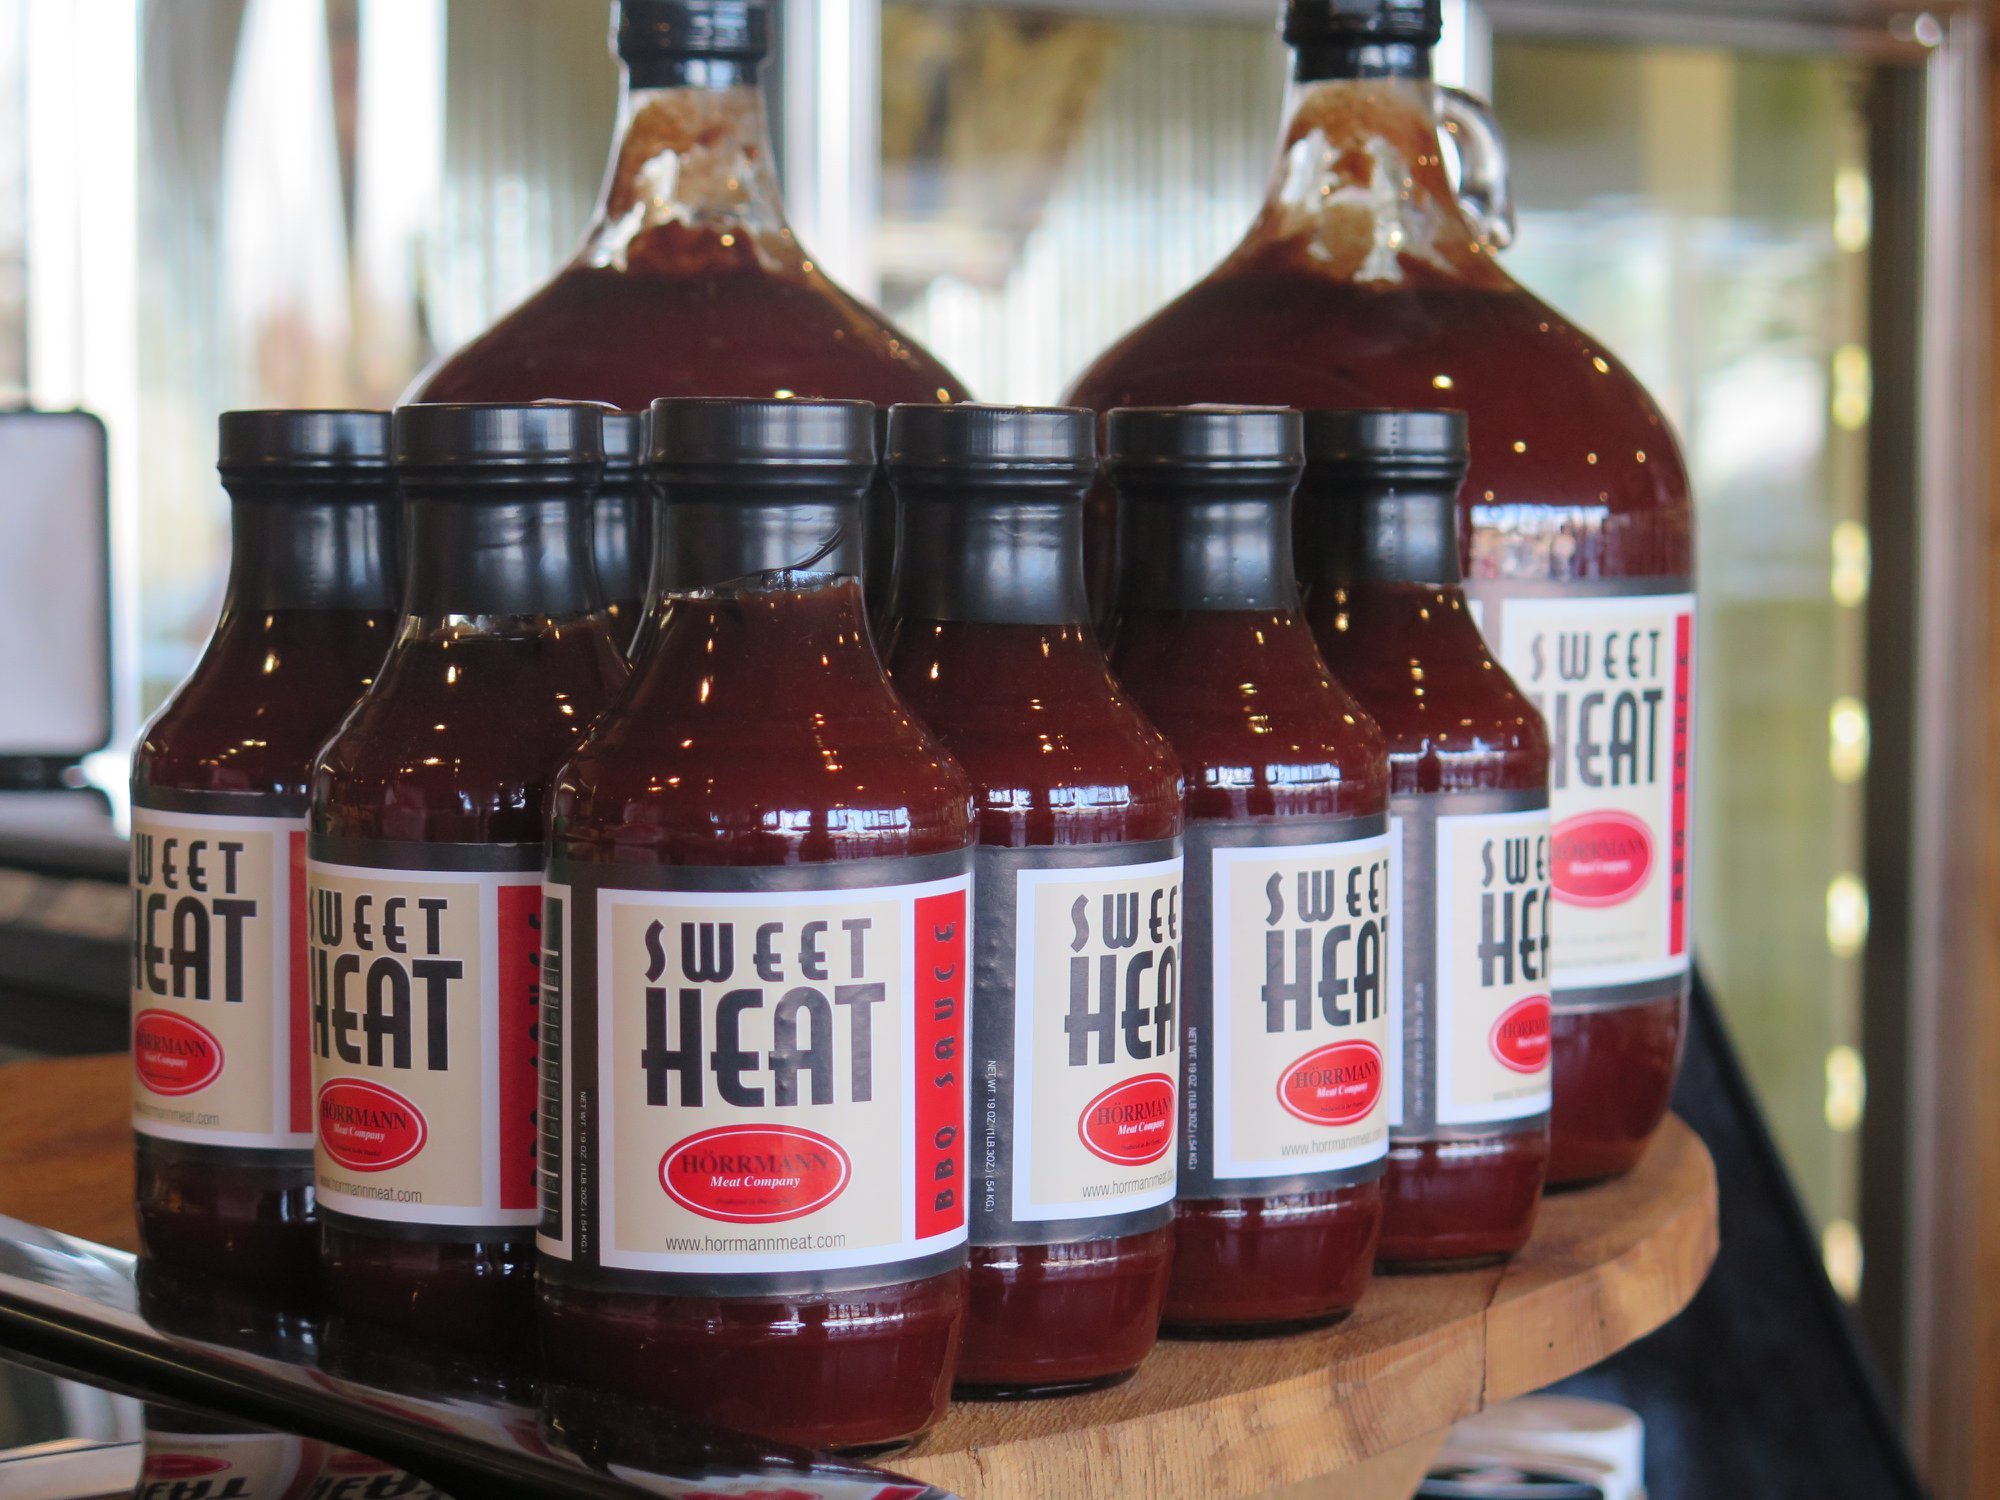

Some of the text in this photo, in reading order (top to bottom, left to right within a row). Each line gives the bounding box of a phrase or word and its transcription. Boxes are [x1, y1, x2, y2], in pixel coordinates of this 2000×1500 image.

[1530, 630, 1660, 682] SWEET
[136, 832, 244, 894] WEET
[1482, 834, 1550, 888] SWE
[1070, 881, 1183, 953] SWEE
[645, 918, 872, 983] SWEET
[310, 945, 463, 1071] HEAT
[1064, 942, 1182, 1067] HEA
[1187, 1026, 1198, 1043] NET
[641, 982, 886, 1108] HEAT
[933, 920, 958, 1213] BBQ SAUCE
[987, 1060, 997, 1077] NET
[1187, 1062, 1198, 1073] 19
[987, 1078, 997, 1094] WT.
[987, 1098, 996, 1109] 19
[986, 1110, 996, 1126] OZ.
[349, 1125, 387, 1143] Company
[1118, 1119, 1166, 1136] Meat Company
[580, 1132, 587, 1143] 19
[681, 1149, 829, 1175] HÖRRMANN
[710, 1174, 801, 1189] Meat Company
[985, 1194, 995, 1212] KG.)
[665, 1233, 846, 1252] www.horrmannmeat.com
